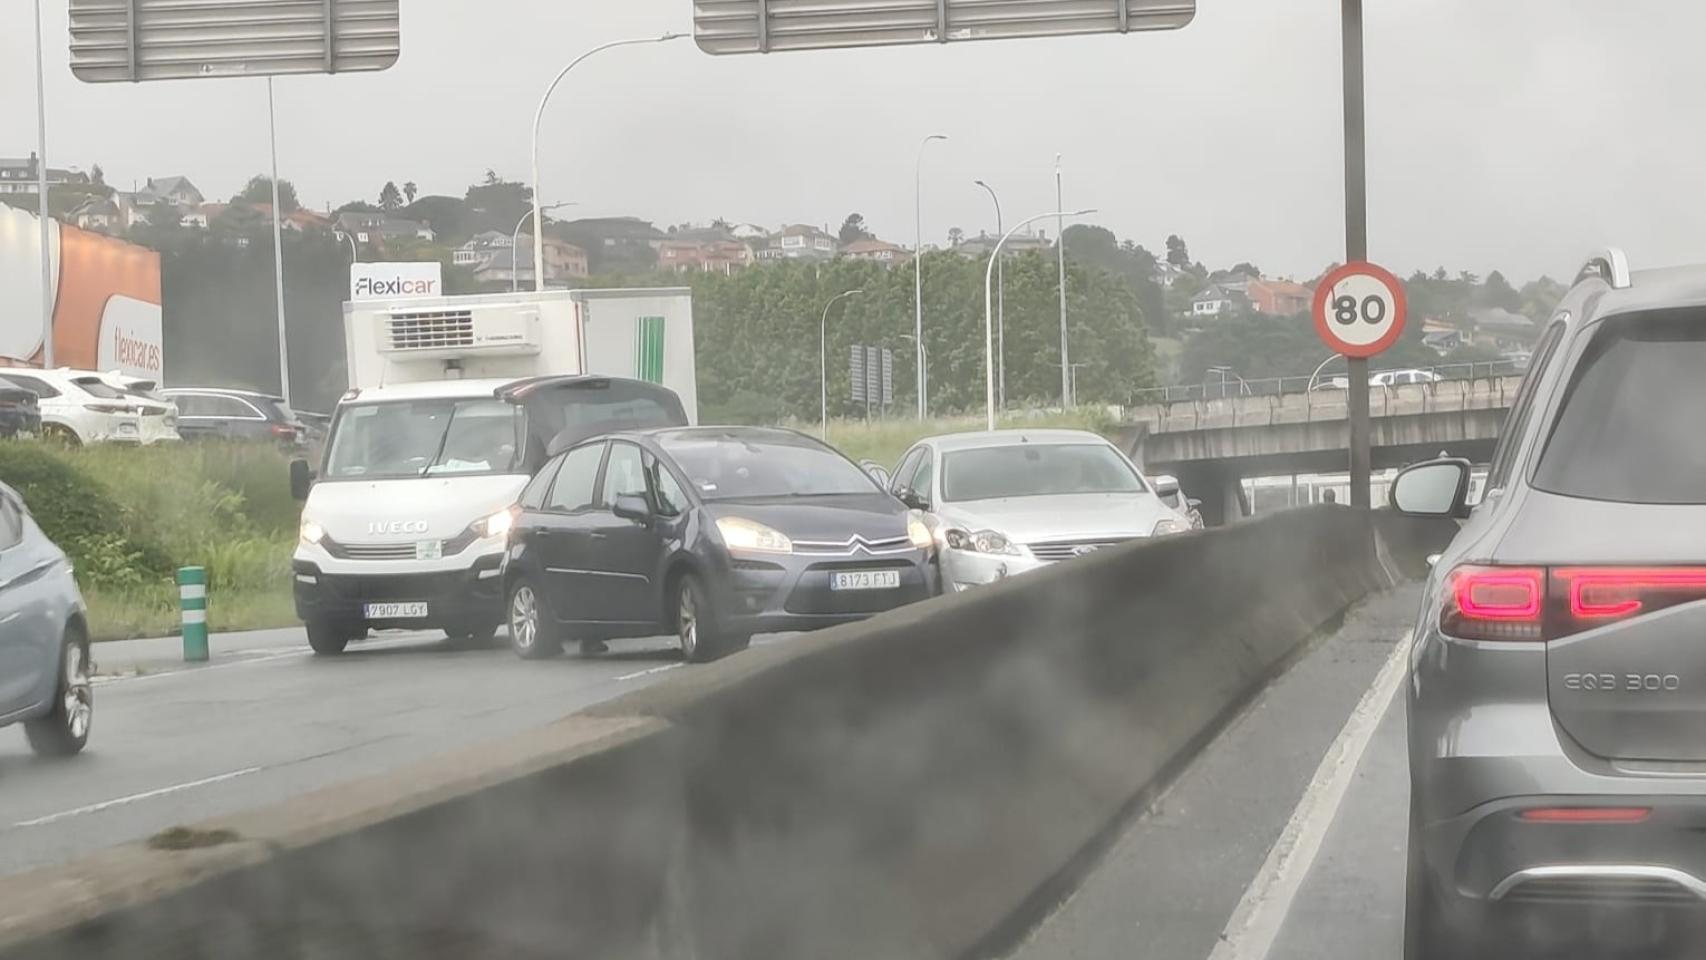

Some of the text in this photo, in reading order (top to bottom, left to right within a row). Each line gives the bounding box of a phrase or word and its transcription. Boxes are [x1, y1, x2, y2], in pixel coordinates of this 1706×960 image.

[355, 276, 435, 295] Flexicar
[1335, 294, 1386, 325] 80
[114, 325, 160, 371] flexicar.es
[367, 519, 429, 535] IVECO
[840, 572, 896, 587] 8173 FTJ
[370, 604, 400, 617] 7907
[1563, 673, 1680, 690] EQB 300
